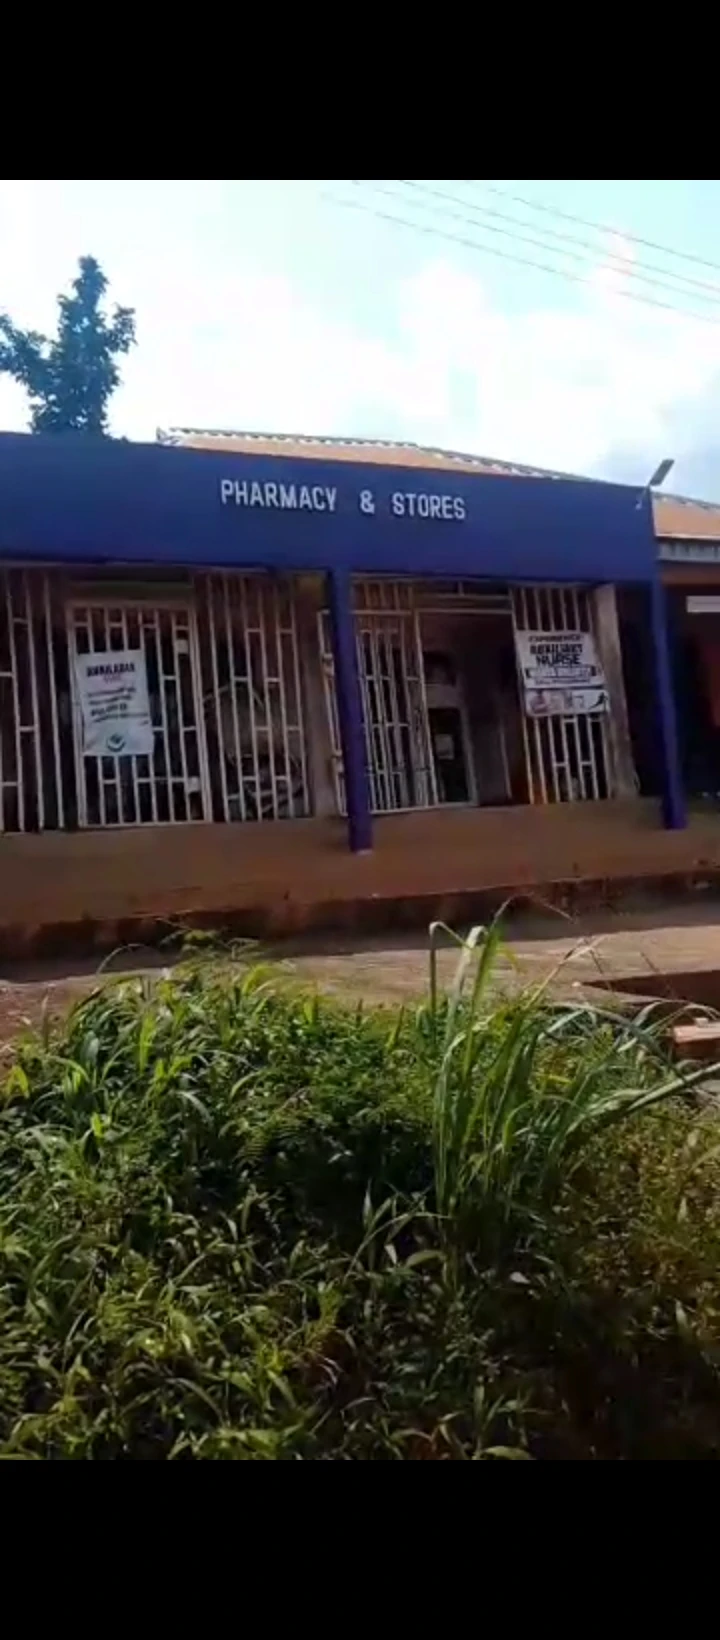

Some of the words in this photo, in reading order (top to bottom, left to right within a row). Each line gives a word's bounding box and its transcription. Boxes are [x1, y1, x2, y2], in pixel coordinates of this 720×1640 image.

[220, 479, 337, 511] PHARMACY
[359, 490, 375, 514] &
[391, 492, 466, 519] STORES
[536, 653, 581, 667] NURSE
